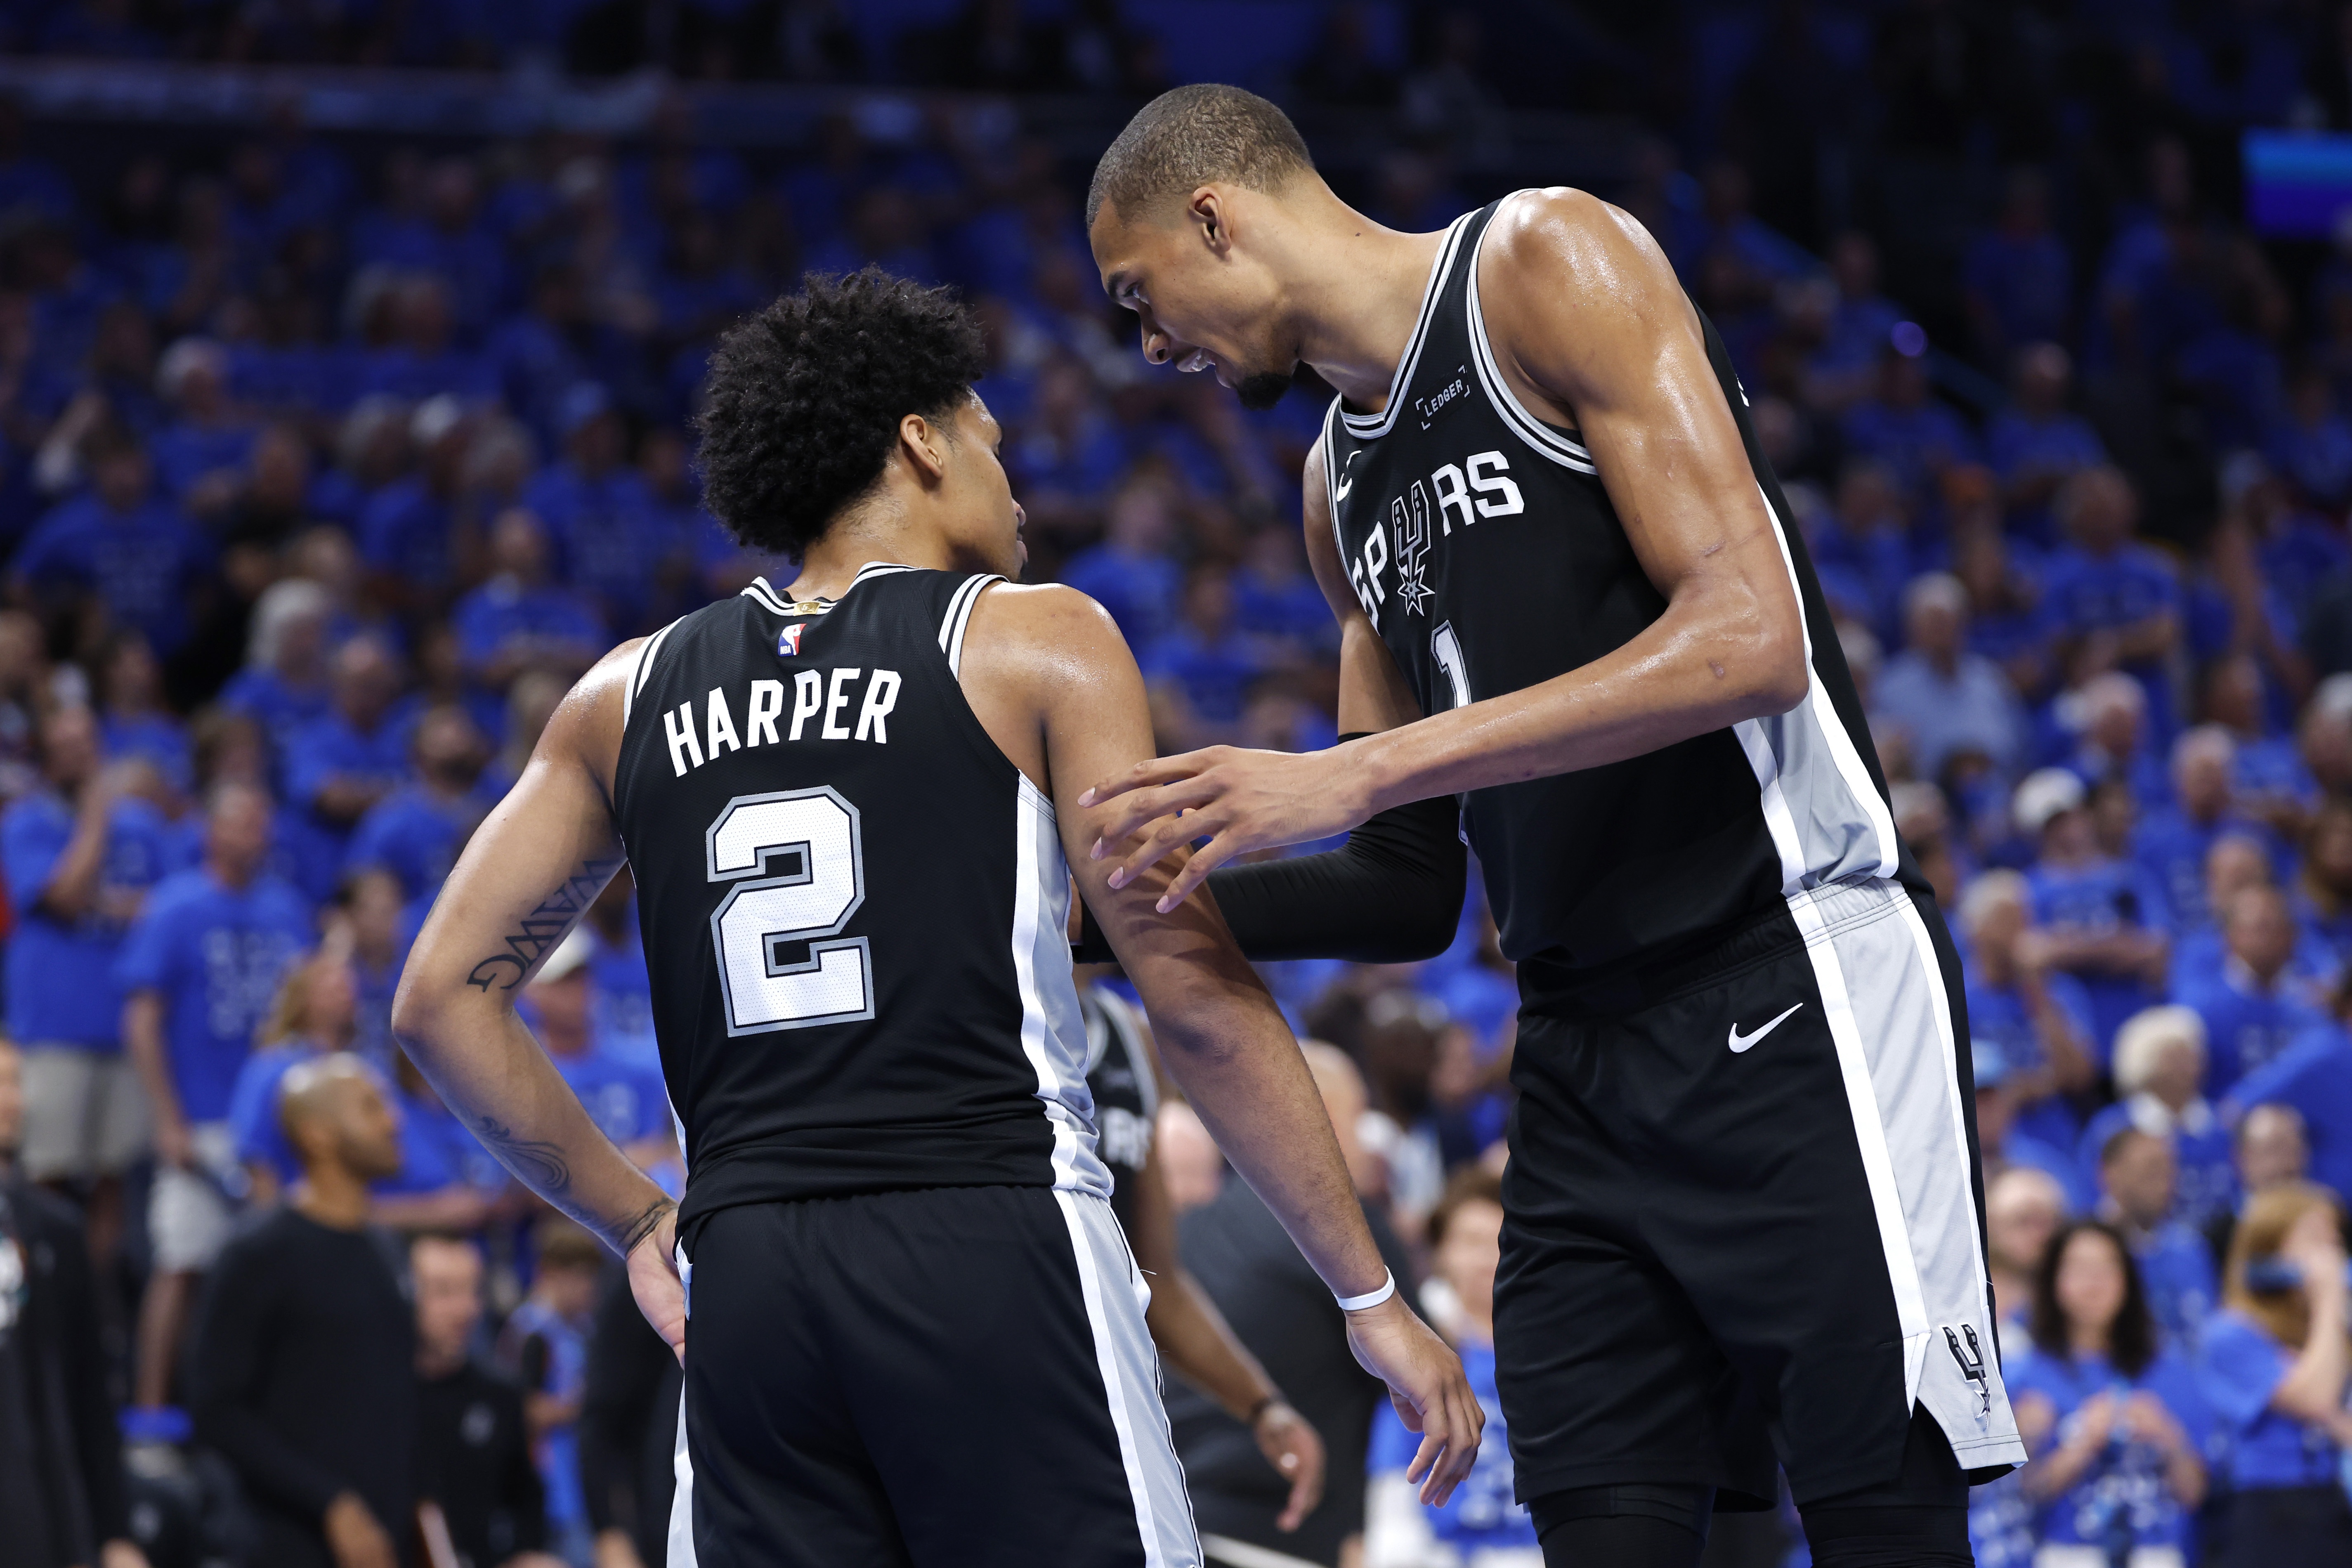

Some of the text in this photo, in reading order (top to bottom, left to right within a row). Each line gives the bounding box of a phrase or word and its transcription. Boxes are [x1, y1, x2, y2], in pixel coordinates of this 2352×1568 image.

[1424, 379, 1463, 418] LEDGER
[1352, 451, 1524, 635] SPURS
[780, 645, 791, 655] NBA
[1431, 619, 1472, 707] 1
[663, 668, 902, 777] HARPER
[706, 785, 875, 1037] 2
